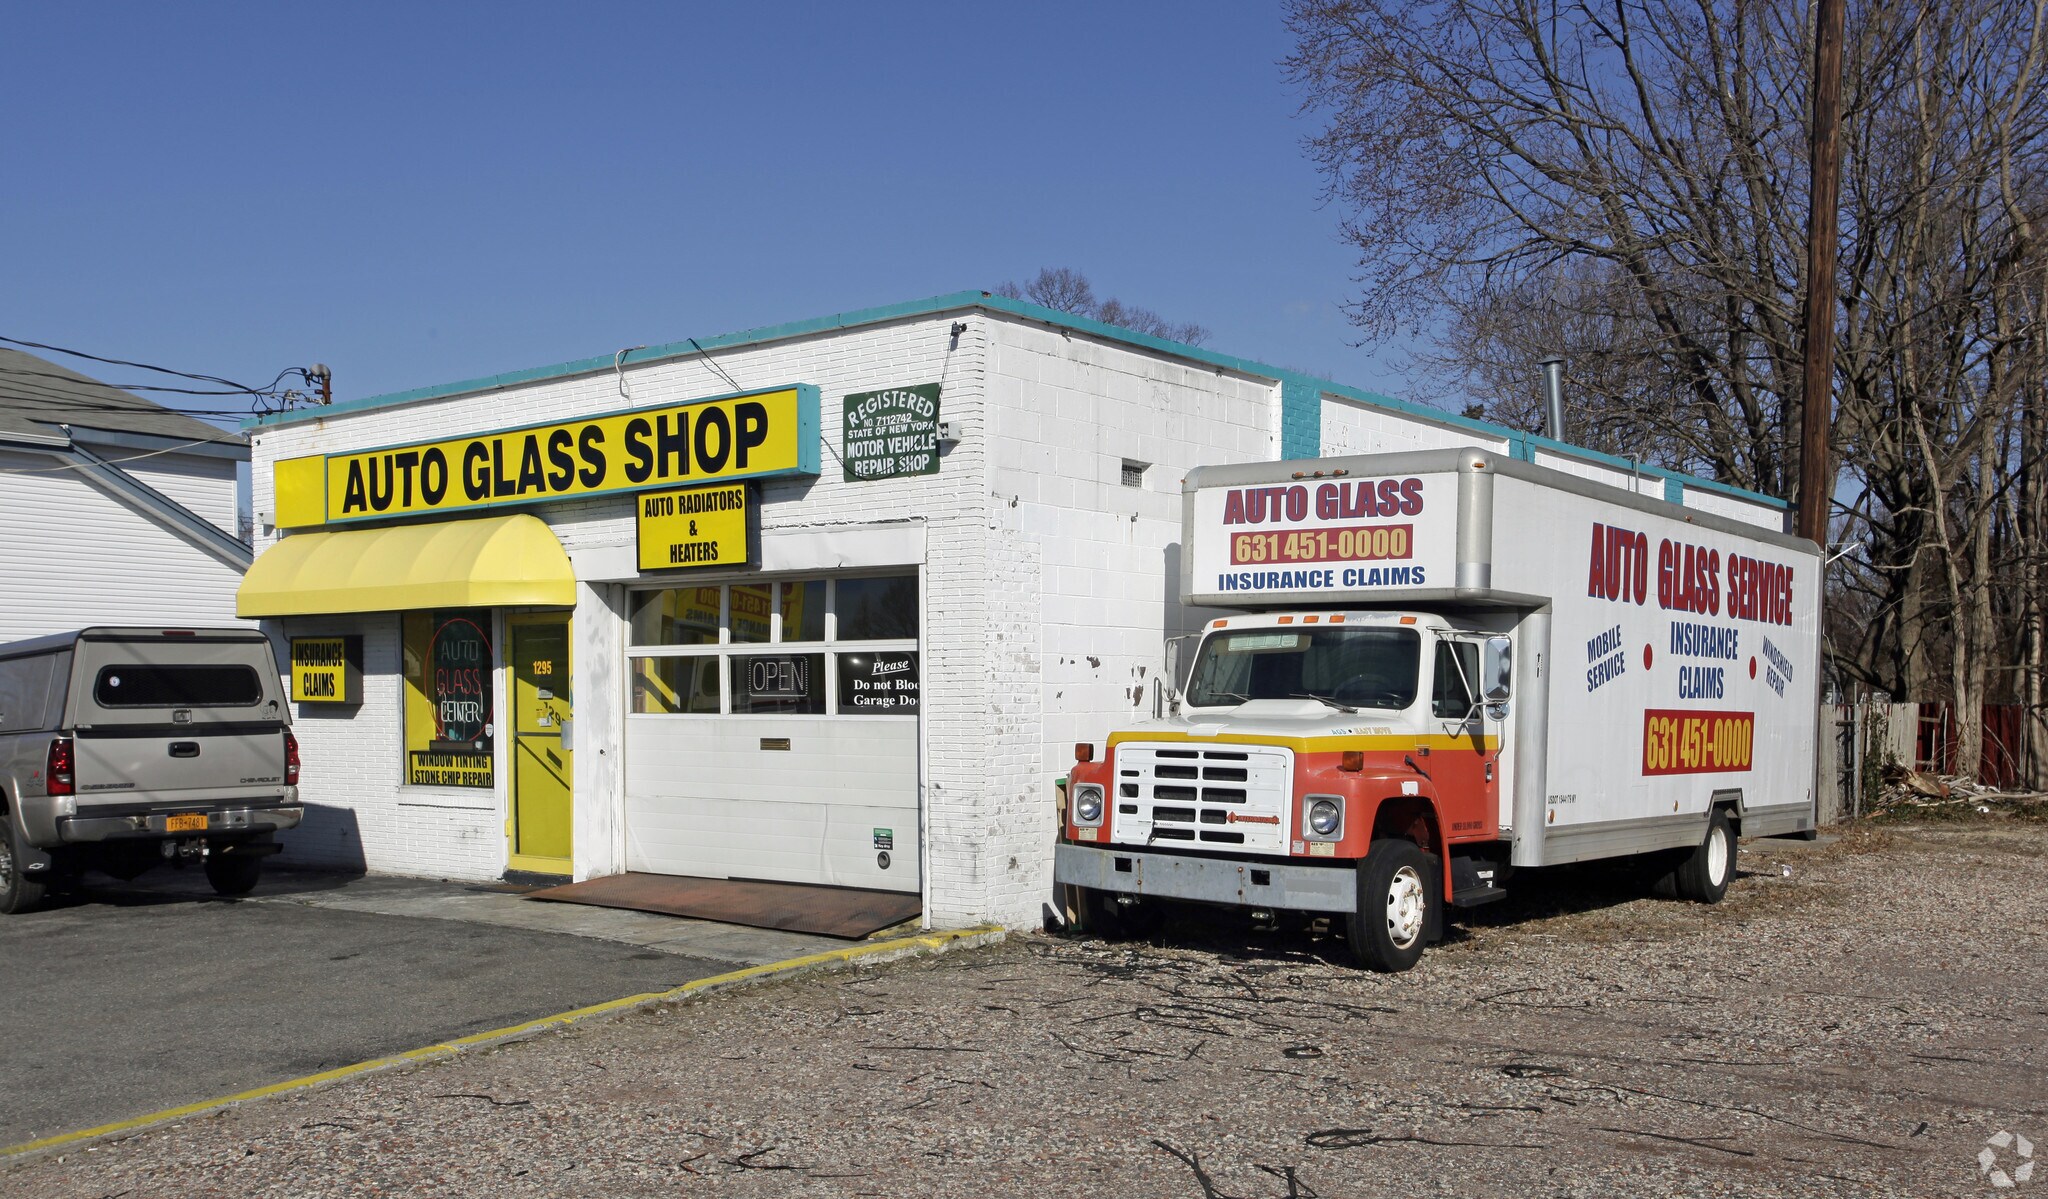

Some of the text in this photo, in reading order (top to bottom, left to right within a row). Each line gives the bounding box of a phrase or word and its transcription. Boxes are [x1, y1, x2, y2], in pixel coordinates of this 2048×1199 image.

[847, 390, 934, 428] REGISTERED
[876, 412, 912, 426] 7112742
[848, 421, 934, 439] STATE OF NEW YORK
[342, 401, 768, 514] AUTO GLASS SHOP
[847, 433, 936, 459] MOTOR VEHICLE
[855, 454, 930, 477] REPAIR SHOP
[644, 488, 744, 518] AUTO RADIATORS
[1222, 477, 1425, 526] AUTO GLASS
[688, 520, 698, 537] &
[669, 540, 718, 563] HEATERS
[1235, 528, 1407, 563] 631 451-0000
[1218, 565, 1426, 592] INSURANCE CLAIMS
[1588, 522, 1795, 626] AUTO GLASS SERVICE
[441, 639, 479, 661] AUTO
[1587, 623, 1623, 665] MOBILE
[1670, 621, 1738, 661] INSURANCE
[295, 642, 343, 667] INSURANCE
[533, 660, 552, 675] 1295
[872, 660, 909, 673] Please
[1762, 635, 1794, 683] WINDSHIELD
[436, 668, 482, 695] GLASS
[752, 660, 806, 692] OPEN
[854, 679, 870, 690] Do
[873, 680, 891, 690] not
[1586, 649, 1626, 694] SERVICE
[1678, 665, 1724, 700] CLAIMS
[1765, 664, 1786, 699] REPAIR
[303, 672, 335, 698] CLAIMS
[440, 700, 482, 723] CENTER
[854, 694, 896, 708] Garage
[1647, 716, 1751, 770] 631 451-0000
[417, 753, 488, 770] WINDOW TINTING
[415, 769, 493, 787] STONE CHIP REPAIR
